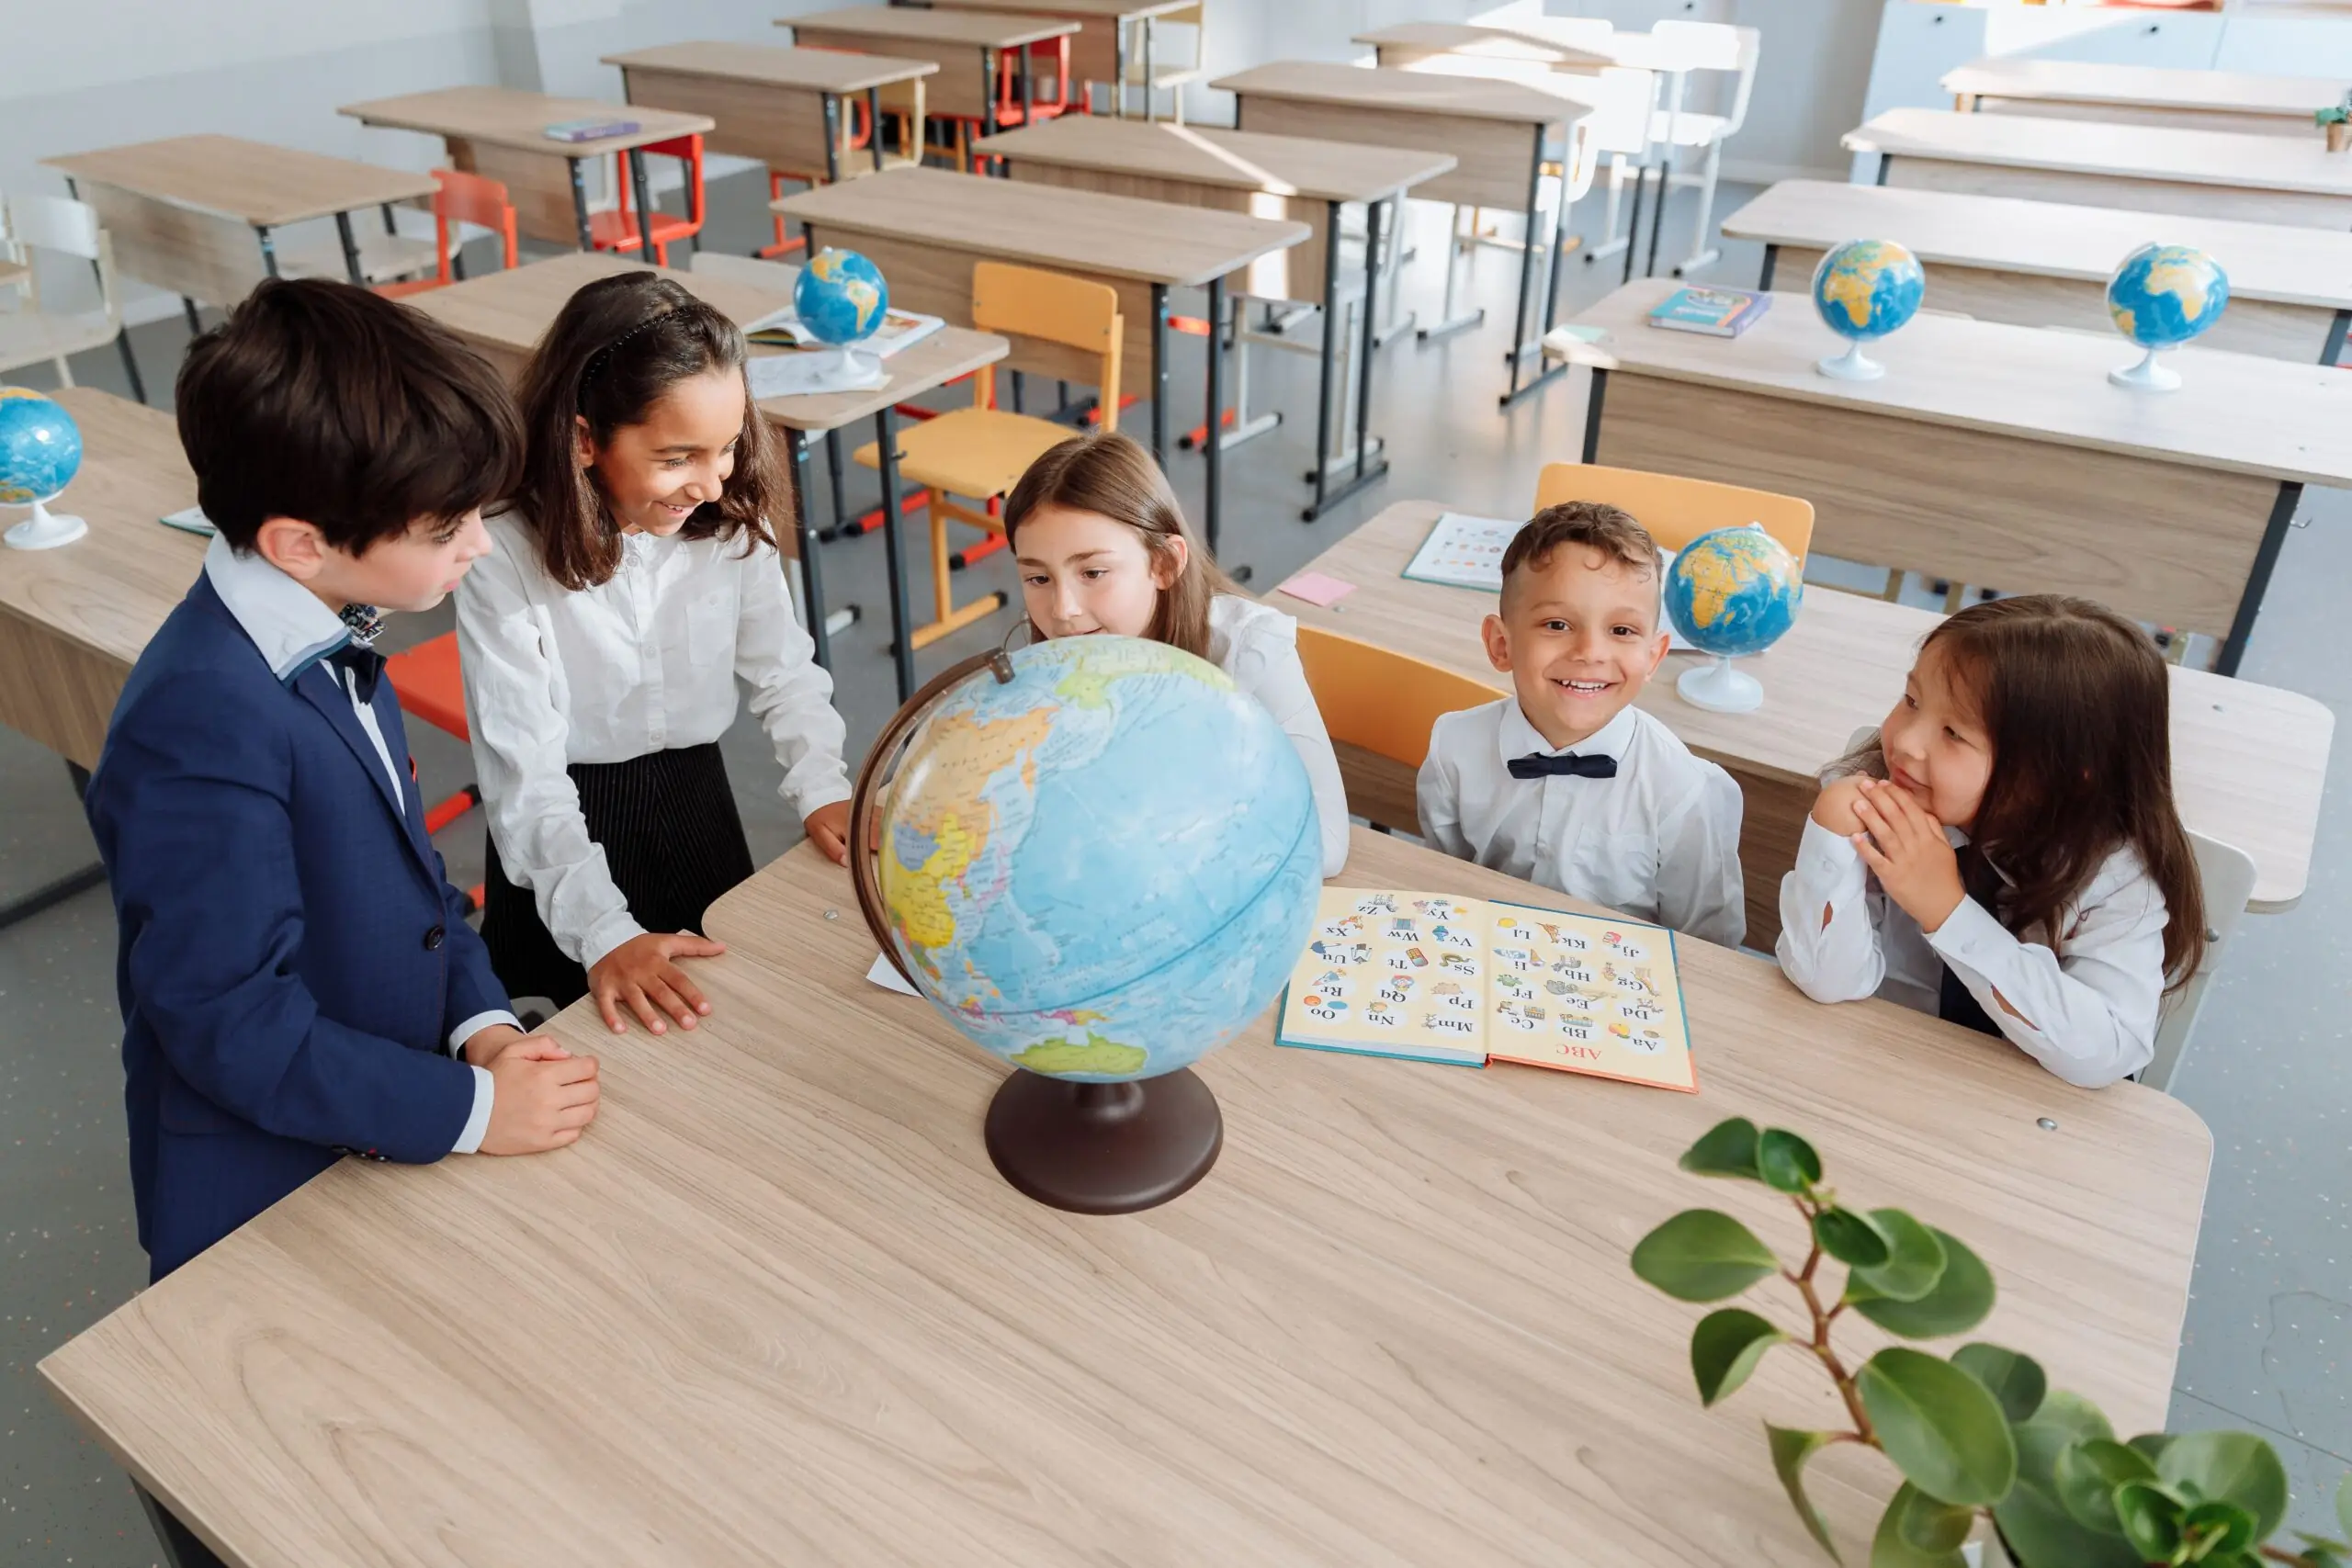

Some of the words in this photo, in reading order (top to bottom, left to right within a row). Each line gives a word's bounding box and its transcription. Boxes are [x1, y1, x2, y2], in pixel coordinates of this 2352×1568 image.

[1358, 905, 1377, 916] Zz
[1427, 908, 1449, 920] Yy
[1326, 927, 1349, 936] Xx
[1387, 931, 1419, 942] Ww
[1513, 929, 1532, 940] Ll
[1450, 936, 1473, 947] Vv
[1563, 937, 1587, 949] Kk
[1623, 945, 1639, 958] Jj
[1322, 954, 1347, 964] Uu
[1388, 959, 1408, 969] Tt
[1454, 964, 1475, 975] Ss
[1515, 961, 1526, 971] Ii
[1565, 969, 1590, 982] Hh
[1617, 977, 1643, 990] Gg
[1320, 986, 1343, 997] Rr
[1381, 990, 1407, 1003] Qq
[1512, 988, 1533, 999] Ff
[1449, 998, 1474, 1009] Pp
[1566, 997, 1589, 1010] Ee
[1310, 1009, 1336, 1020] Oo
[1623, 1007, 1648, 1021] Dd
[1368, 1014, 1395, 1026] Nn
[1511, 1017, 1534, 1030] Cc
[1438, 1021, 1474, 1032] Mm
[1563, 1026, 1589, 1038] Bb
[1633, 1038, 1657, 1051] Aa
[1555, 1043, 1602, 1060] ABC
